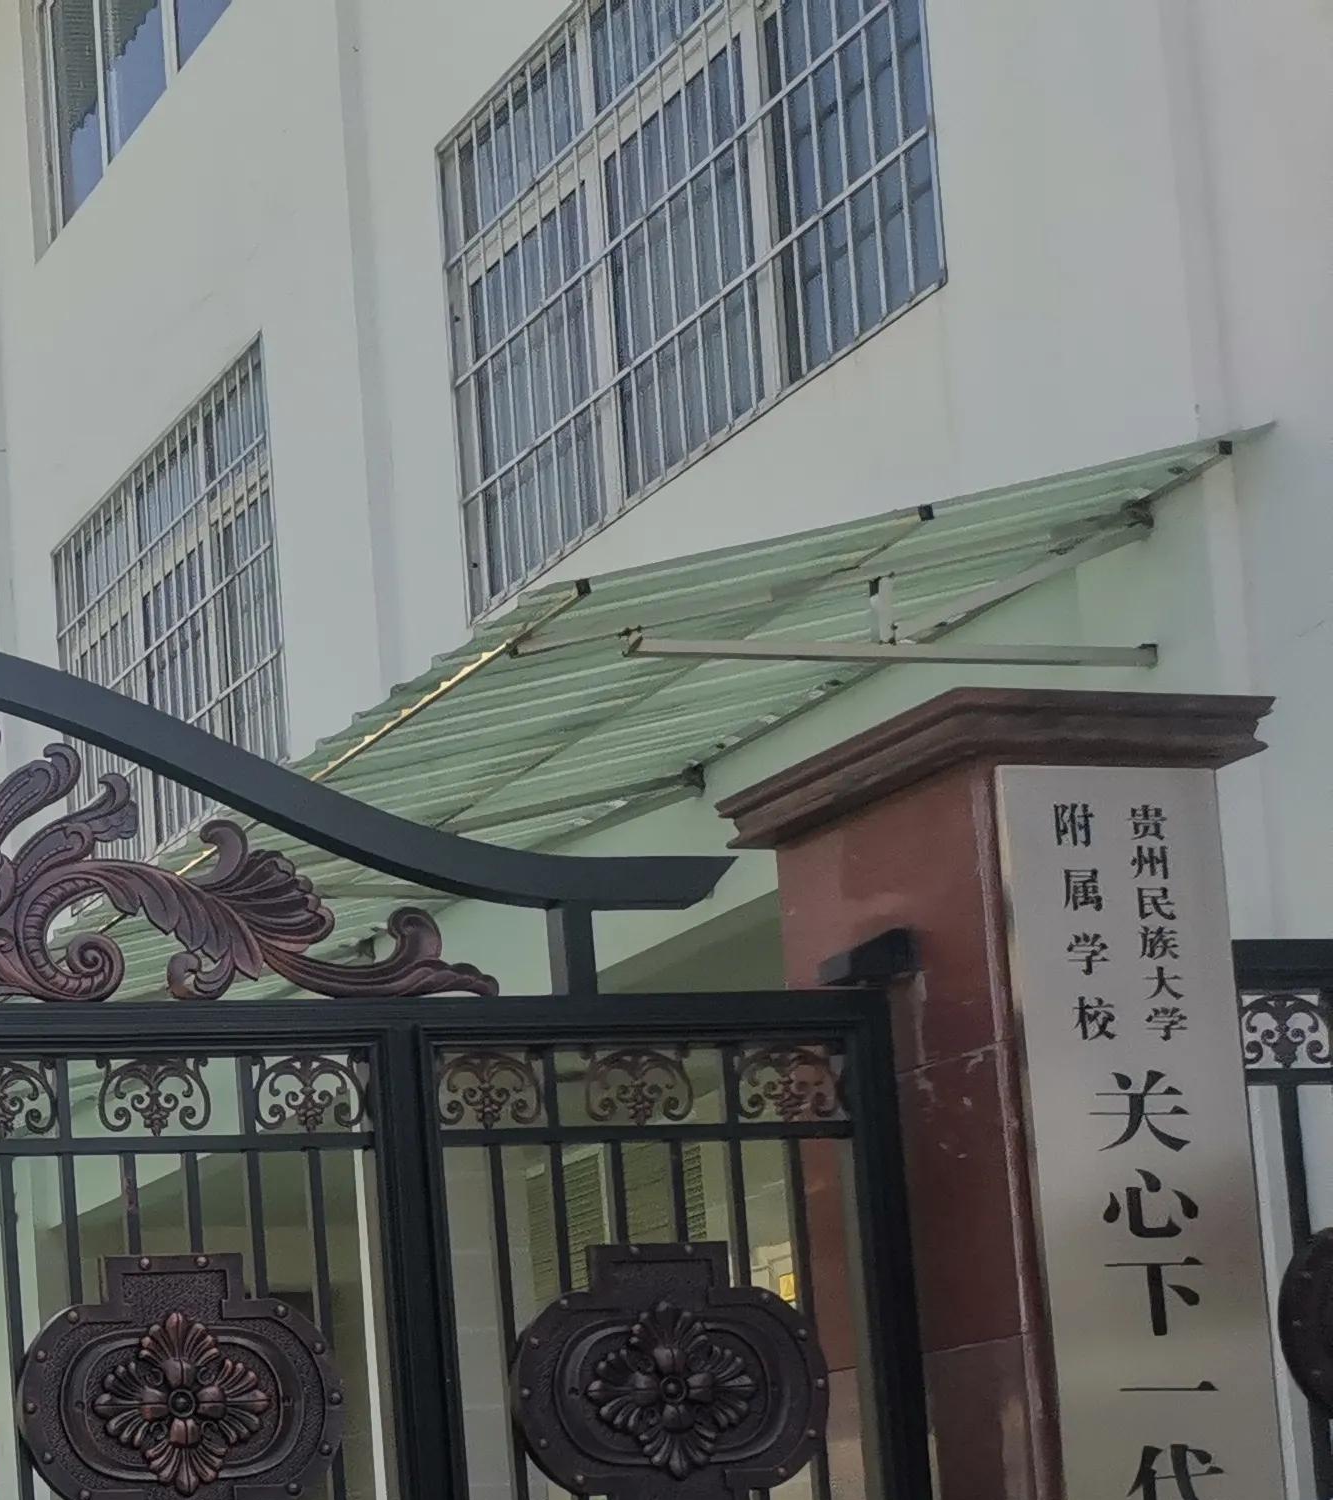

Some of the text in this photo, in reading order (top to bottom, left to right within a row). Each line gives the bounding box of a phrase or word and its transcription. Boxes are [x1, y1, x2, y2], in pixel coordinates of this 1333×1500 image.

[1053, 803, 1117, 1042] 附属学校
[1128, 804, 1188, 1042] 贵州民族大学
